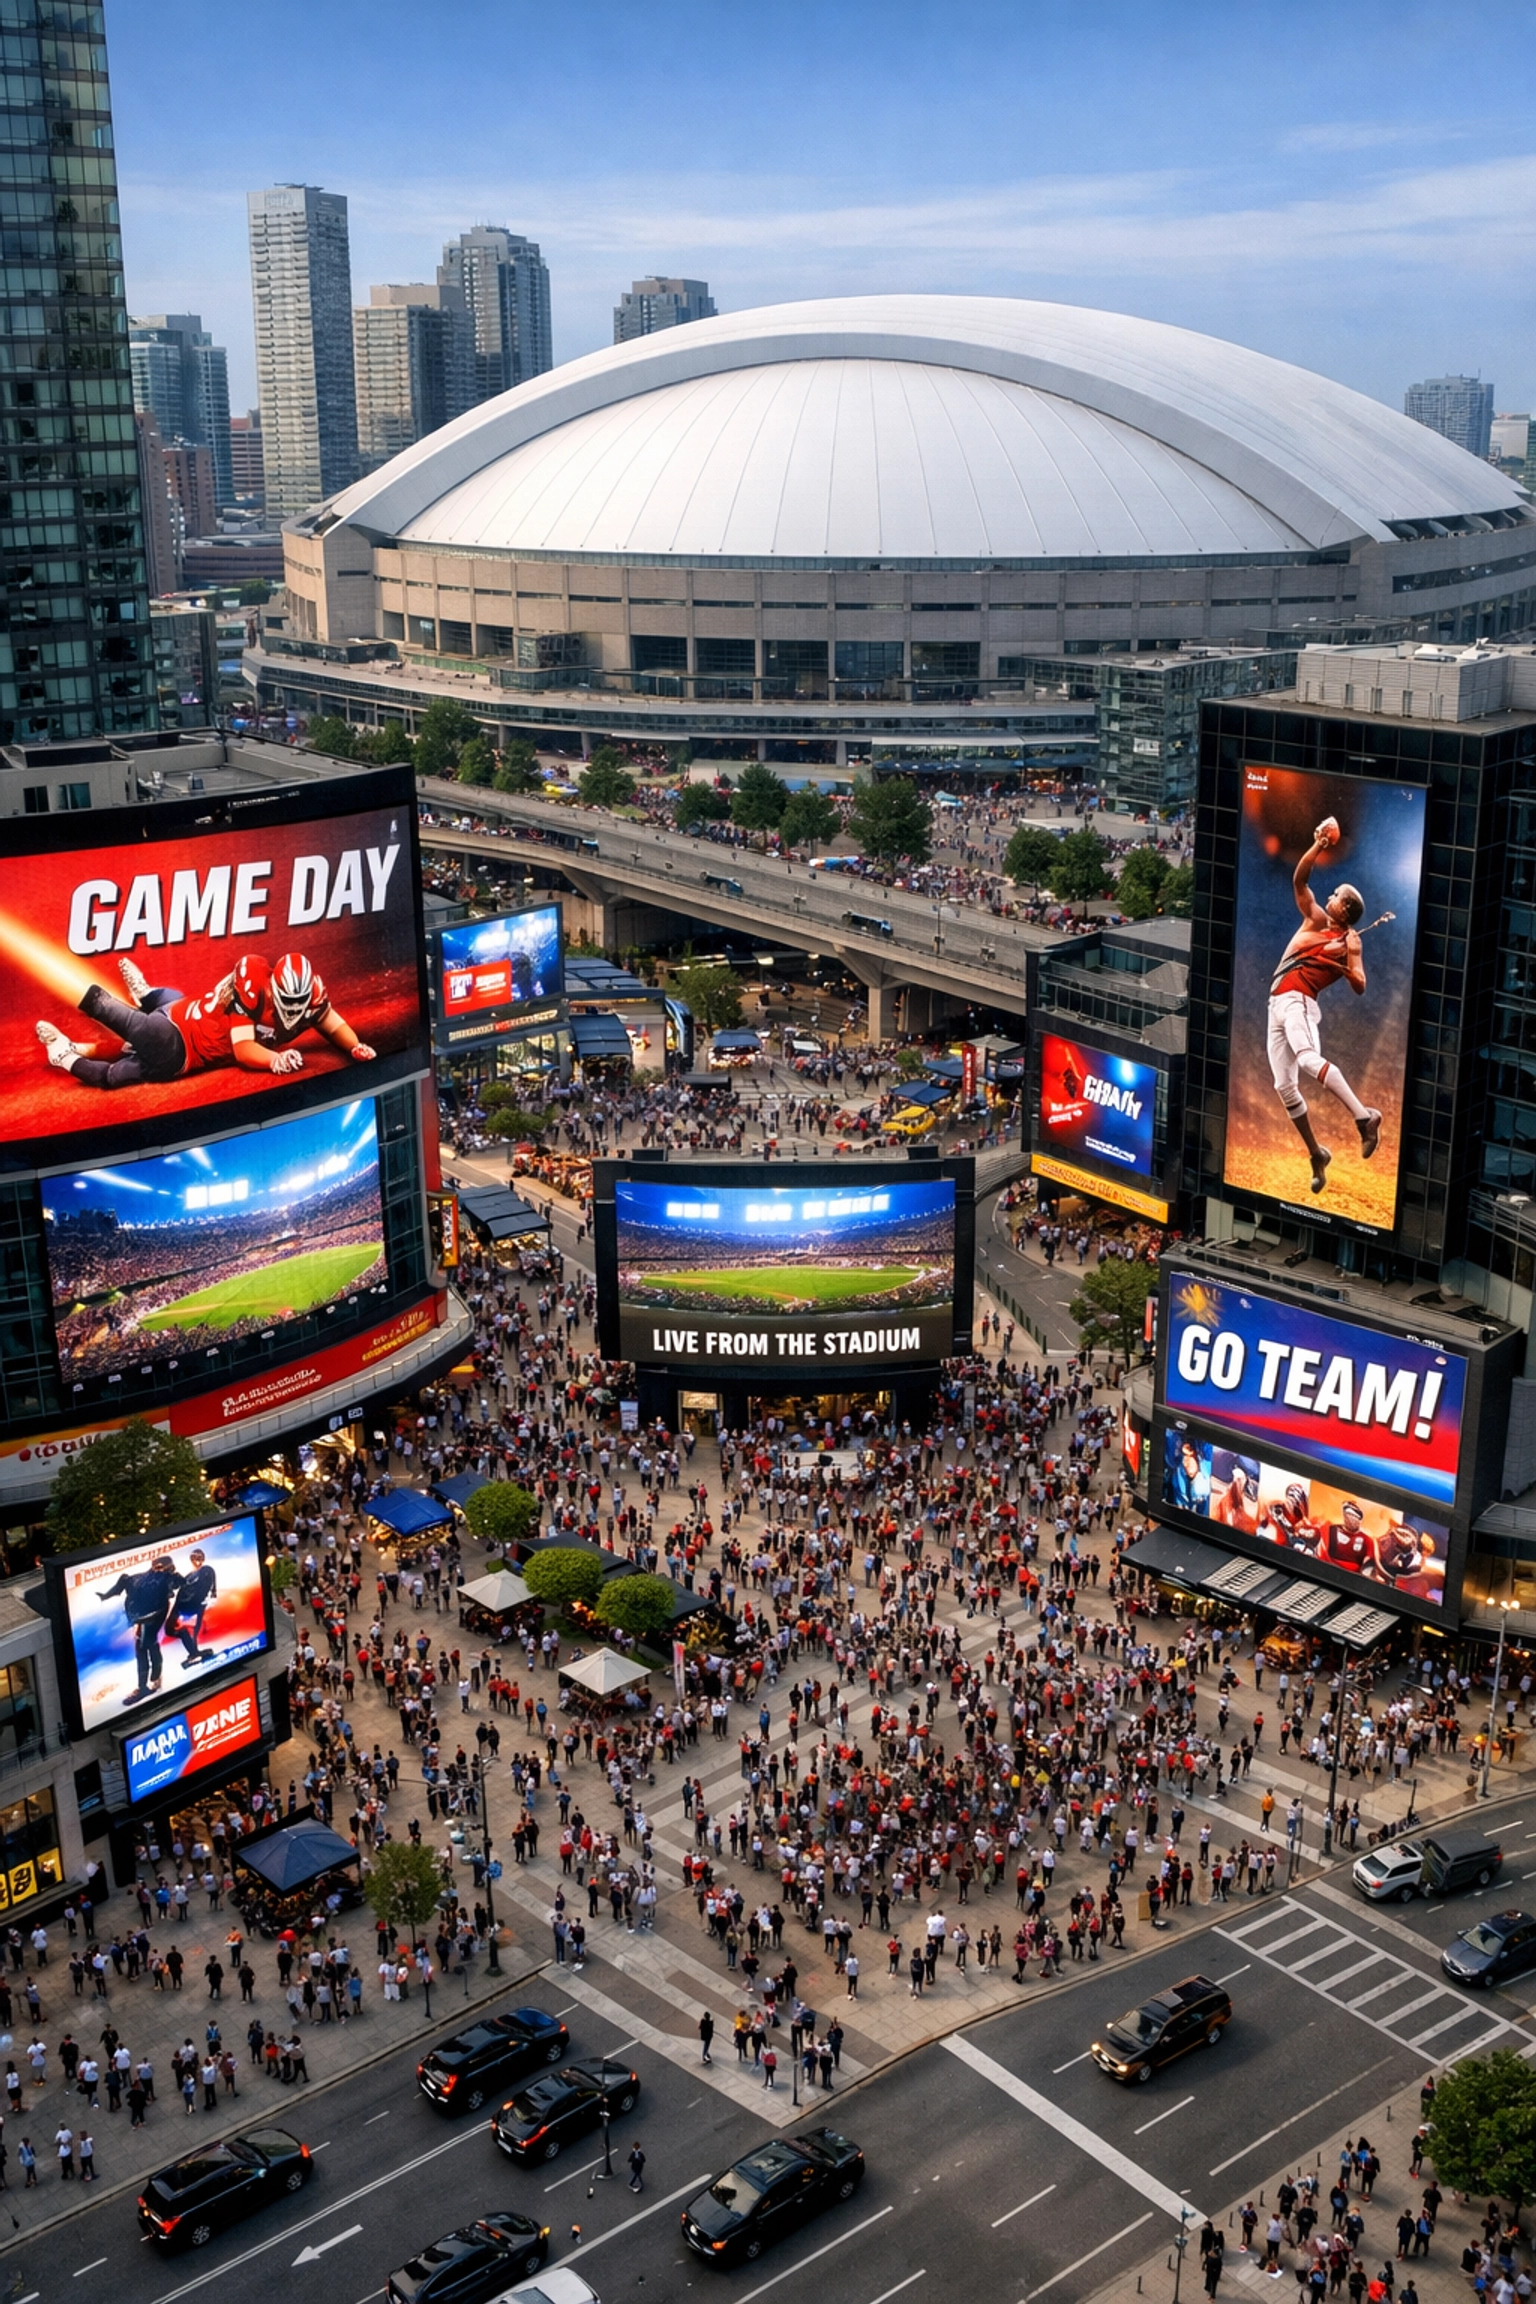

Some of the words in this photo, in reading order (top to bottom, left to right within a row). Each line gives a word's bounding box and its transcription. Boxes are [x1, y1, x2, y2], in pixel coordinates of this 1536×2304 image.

[67, 860, 272, 955] GAME
[287, 843, 401, 926] DAY
[653, 1329, 699, 1353] LIVE
[706, 1332, 768, 1356] FROM
[775, 1333, 817, 1356] THE
[823, 1327, 920, 1355] STADIUM
[1178, 1324, 1245, 1390] GO
[1258, 1339, 1443, 1439] TEAM!
